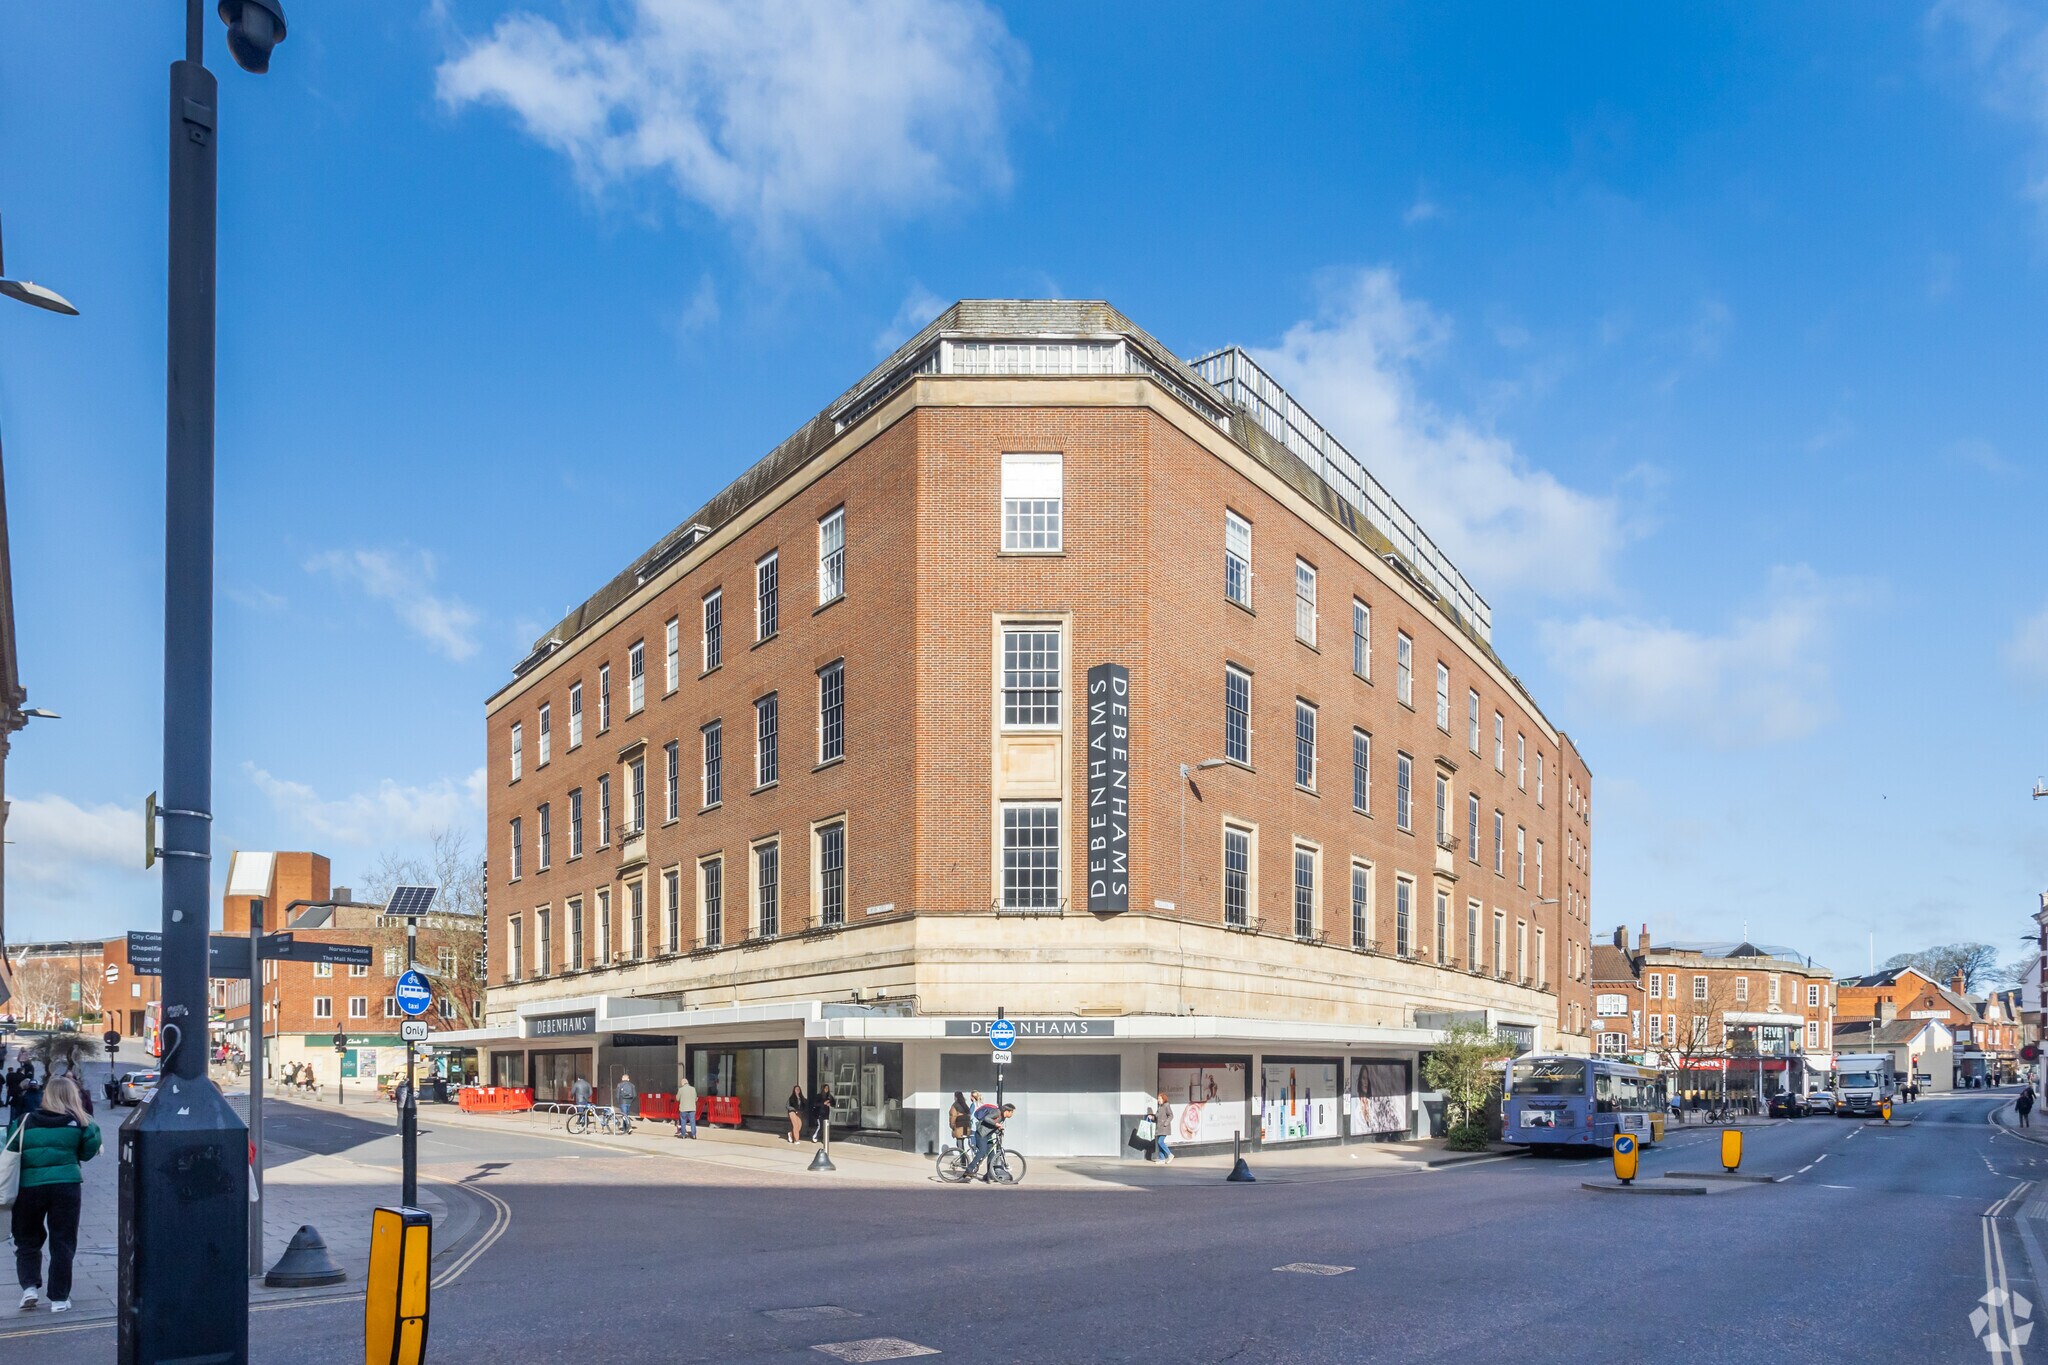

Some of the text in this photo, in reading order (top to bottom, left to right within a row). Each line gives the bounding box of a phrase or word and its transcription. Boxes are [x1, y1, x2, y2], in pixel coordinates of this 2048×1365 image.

[1090, 679, 1106, 898] DEBENHAMS
[1112, 676, 1127, 896] DEBENHAMS
[131, 933, 144, 941] City
[131, 944, 162, 952] Chapelfie
[347, 956, 370, 964] Norwich
[407, 1002, 420, 1010] taxi
[405, 1025, 425, 1037] Only
[537, 1016, 587, 1034] DEBENHAMS
[971, 1021, 1089, 1034] DENHAMS
[1498, 1029, 1532, 1044] EBENHAMS
[994, 1053, 1010, 1062] Only
